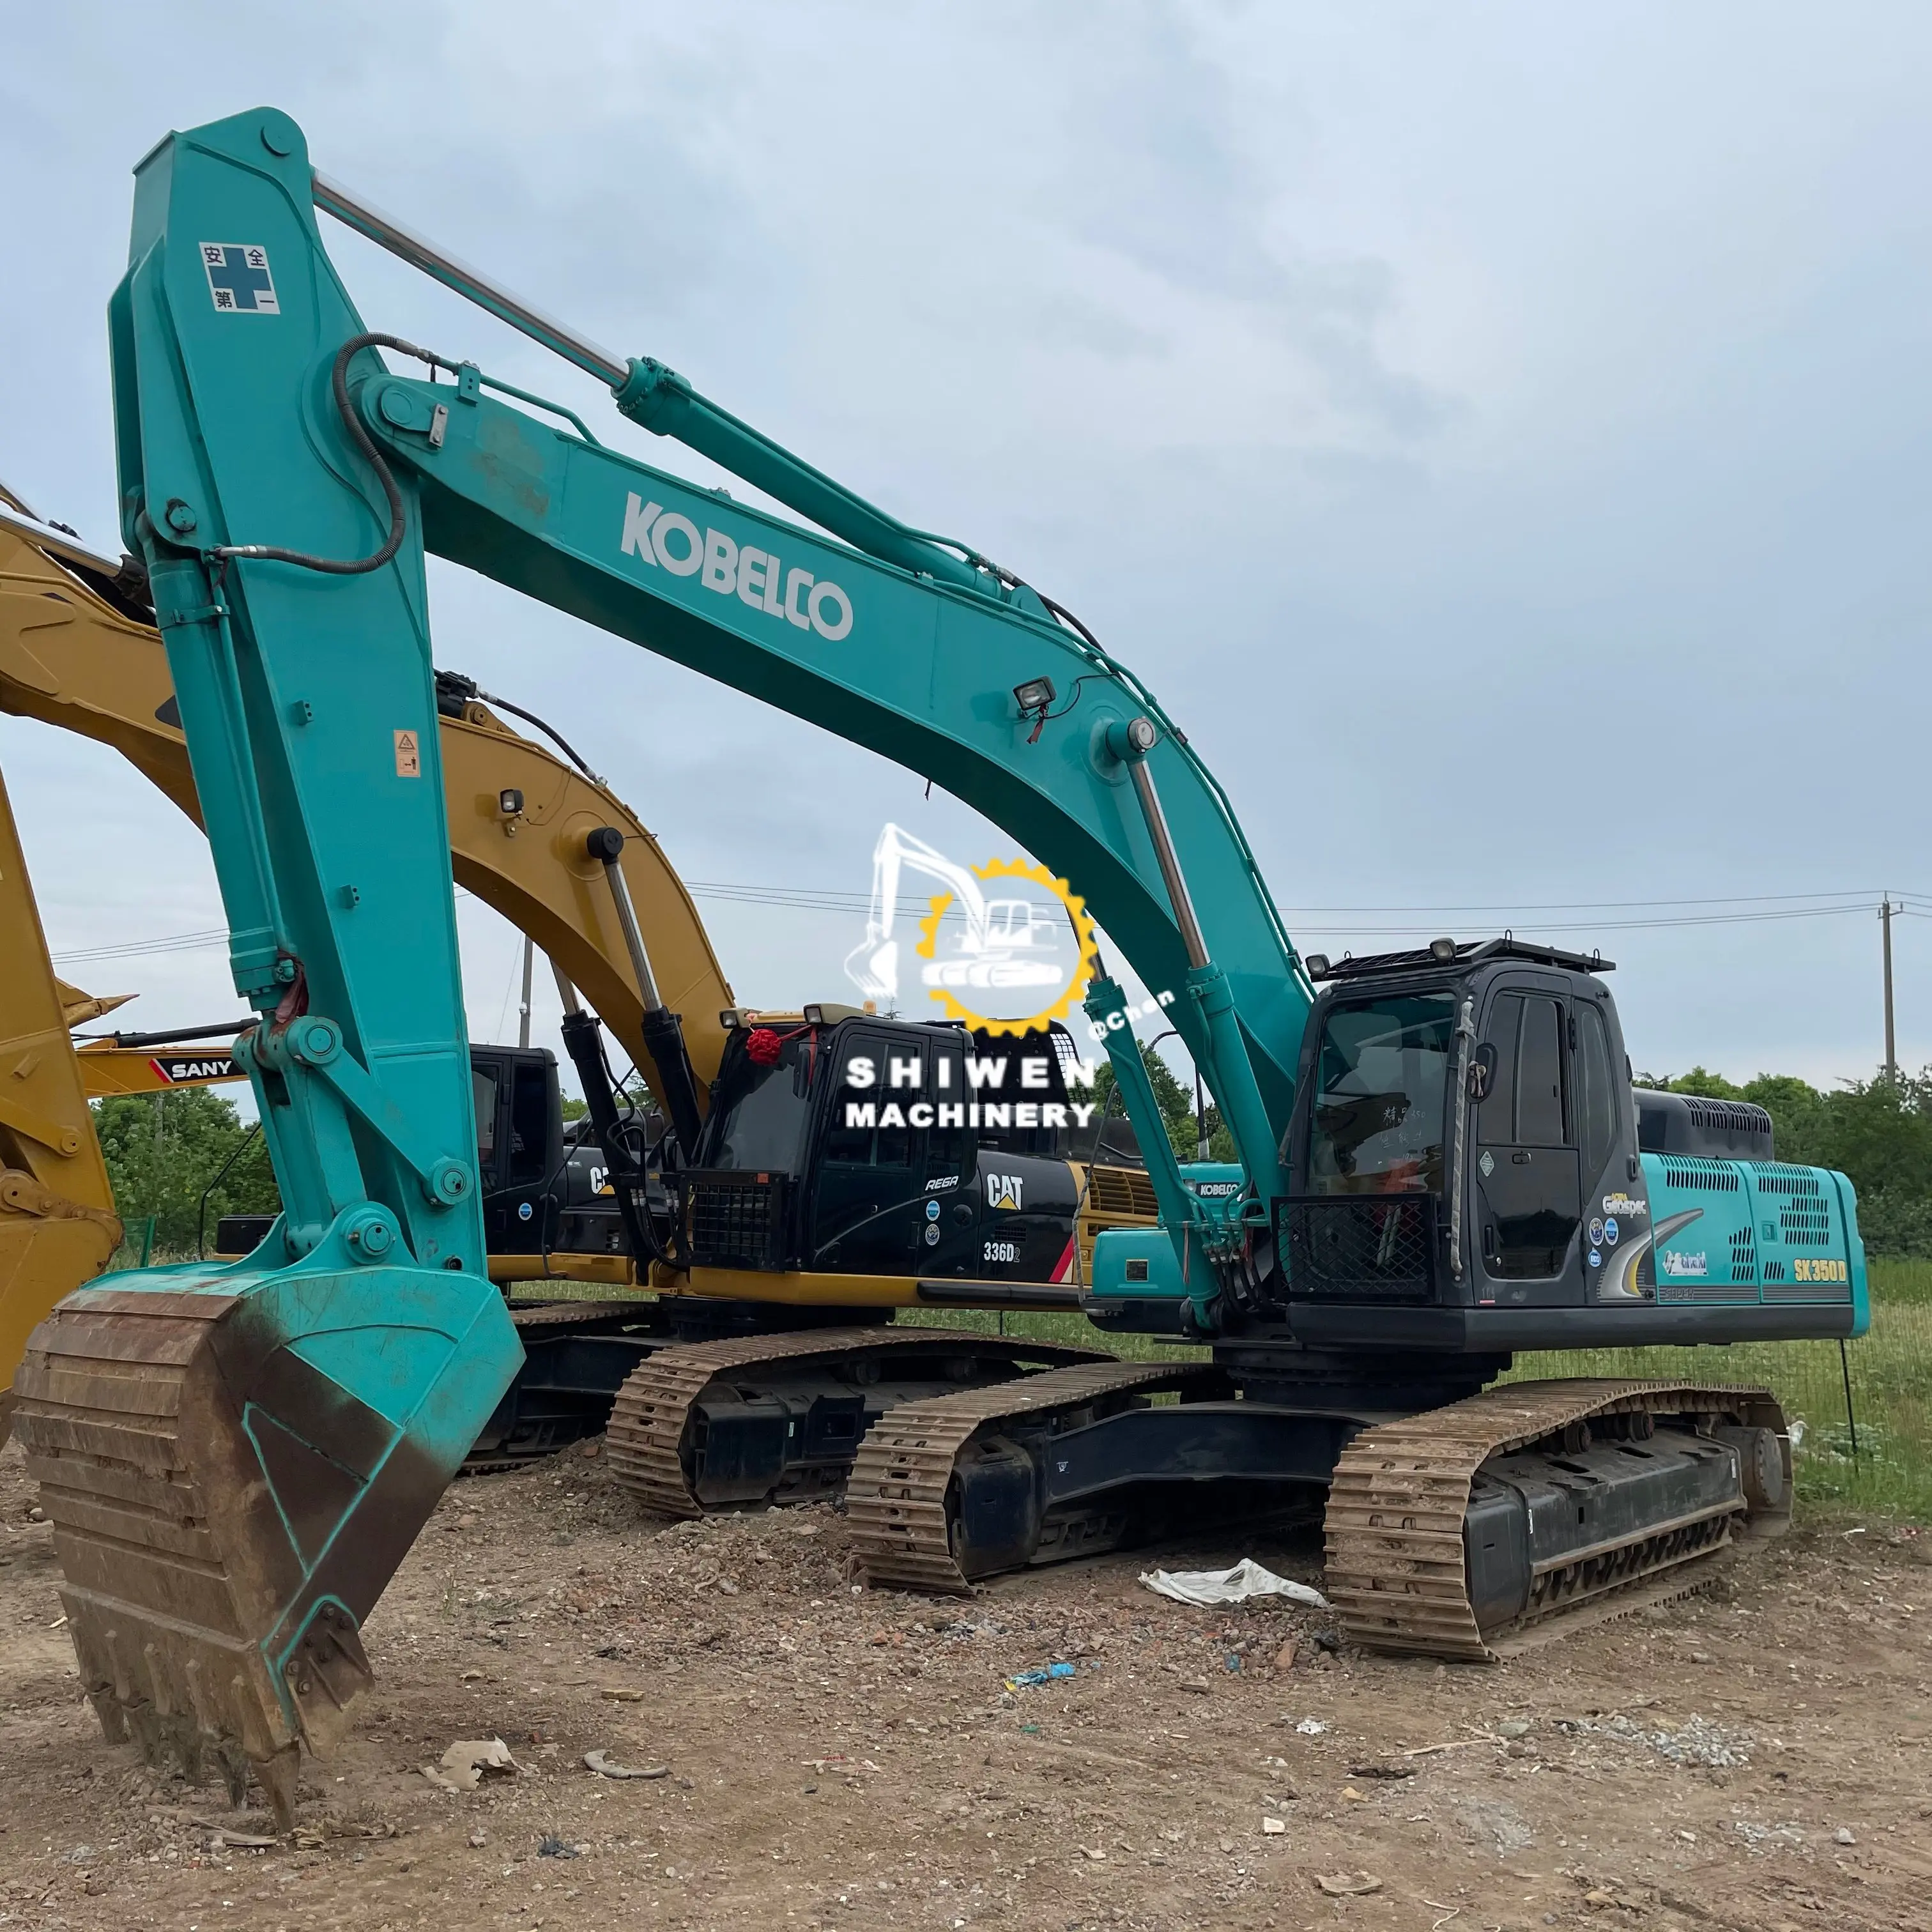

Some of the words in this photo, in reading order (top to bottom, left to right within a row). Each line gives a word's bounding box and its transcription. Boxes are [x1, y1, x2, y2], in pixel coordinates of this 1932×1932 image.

[620, 491, 854, 641] KOBELCO
[172, 1061, 232, 1078] SANY
[987, 1173, 1023, 1210] CAT
[1602, 1195, 1646, 1218] Geospec
